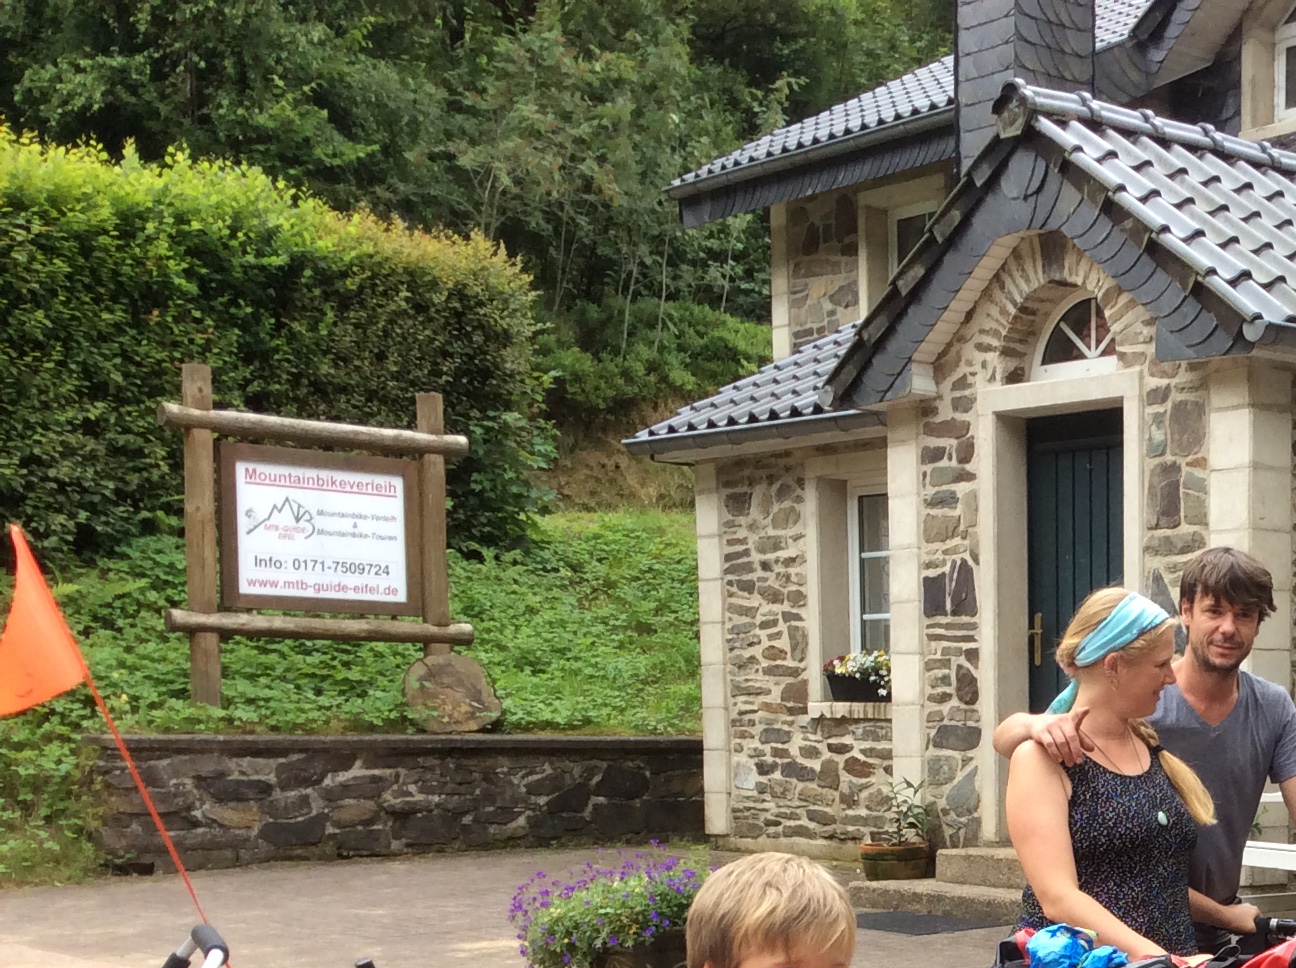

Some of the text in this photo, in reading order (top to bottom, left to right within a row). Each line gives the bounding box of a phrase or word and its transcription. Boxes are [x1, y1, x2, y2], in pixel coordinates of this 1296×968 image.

[244, 467, 397, 494] Mountainbikeverleih
[316, 528, 398, 541] Mountainbike-Touren
[254, 555, 390, 577] Info: 0171-7509724
[246, 578, 399, 596] www.mtb-guide-eifel.de
